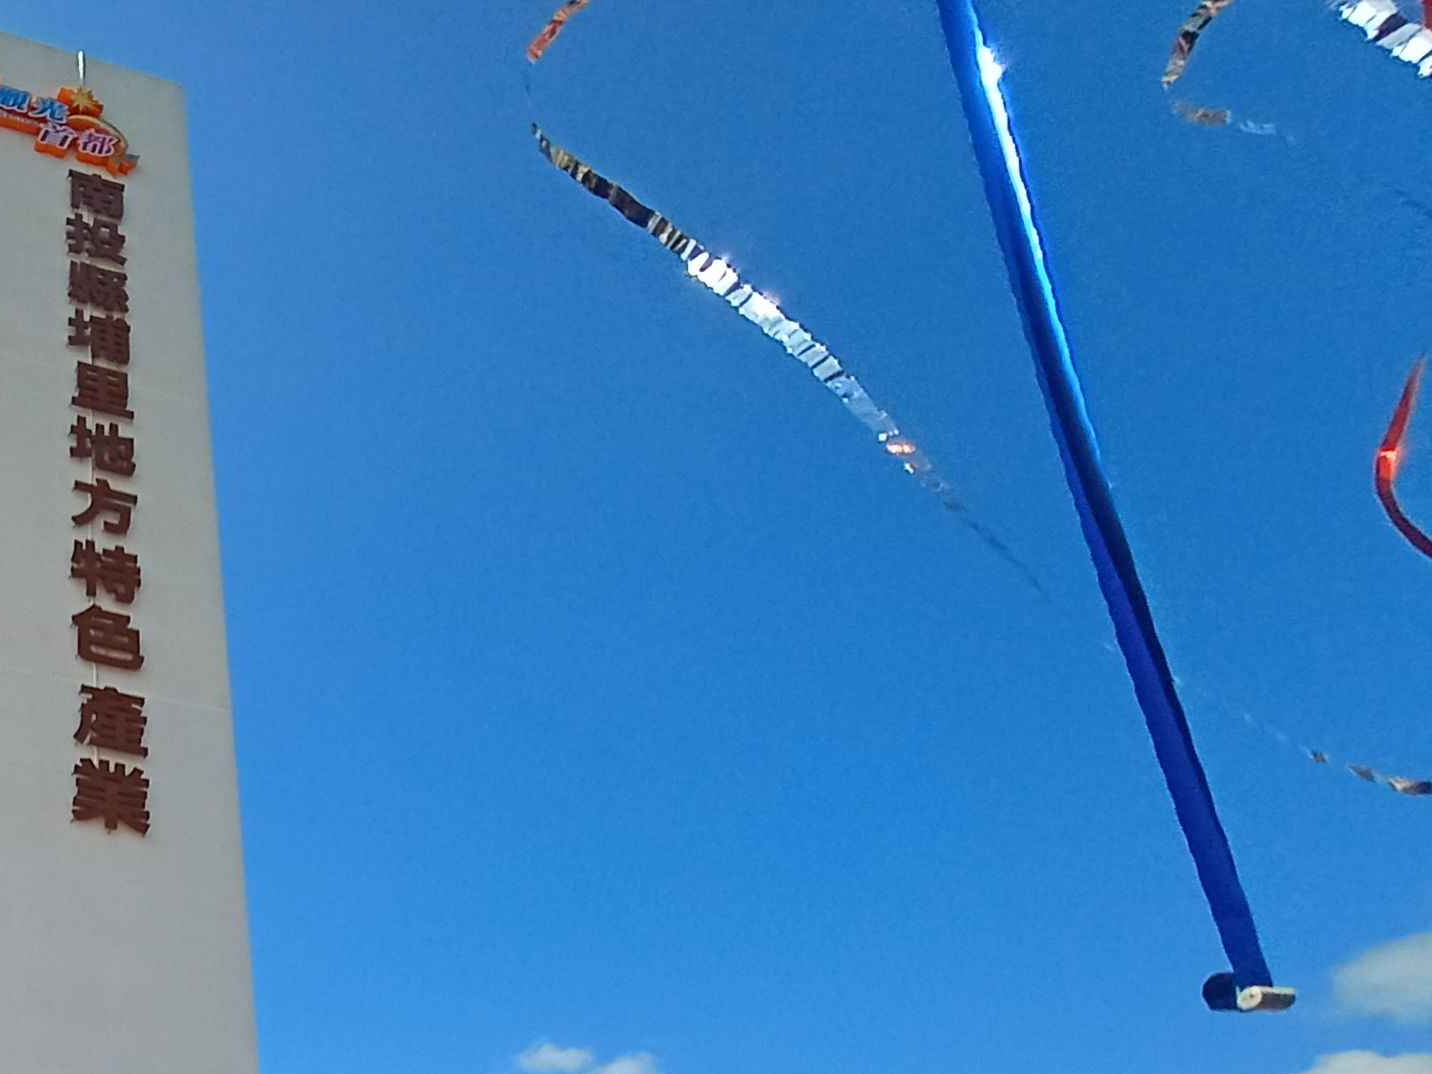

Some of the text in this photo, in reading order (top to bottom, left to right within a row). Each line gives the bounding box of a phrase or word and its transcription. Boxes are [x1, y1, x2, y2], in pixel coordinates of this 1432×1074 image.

[66, 168, 151, 837] 南投縣埔里地方特色產業
